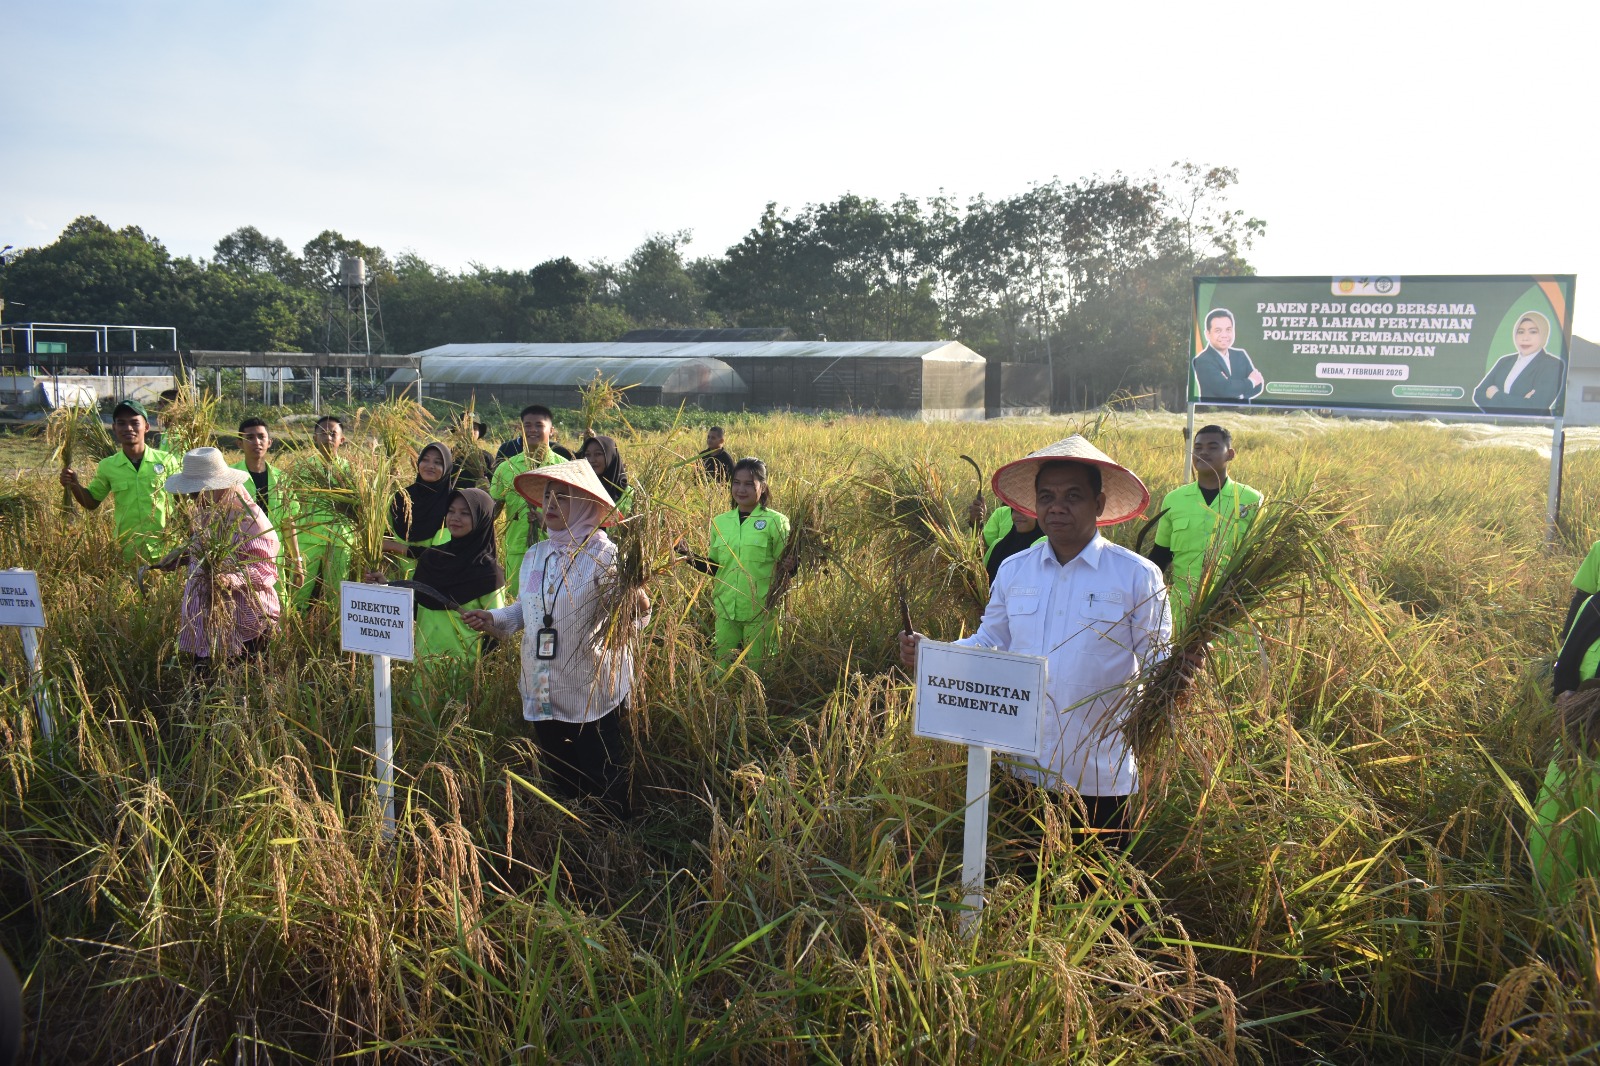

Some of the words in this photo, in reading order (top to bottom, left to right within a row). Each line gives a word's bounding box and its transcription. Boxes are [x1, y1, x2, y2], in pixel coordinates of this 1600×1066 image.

[1257, 303, 1307, 313] PANEN
[1311, 303, 1347, 313] PADI
[1350, 303, 1393, 314] GOGO
[1396, 303, 1476, 315] BERSAMA
[1262, 317, 1277, 327] DI
[1280, 317, 1318, 327] TEFA
[1322, 317, 1376, 328] LAHAN
[1379, 317, 1473, 329] PERTANIAN
[1263, 330, 1348, 341] POLITEKNIK
[1351, 331, 1470, 343] PEMBANGUNAN
[1293, 344, 1377, 355] PERTANIAN
[1380, 345, 1436, 357] MEDAN
[1321, 367, 1345, 375] MEDAN,
[1352, 368, 1384, 376] FEBRUARI
[1, 587, 28, 595] KEPALA
[0, 599, 14, 607] UNIT
[15, 599, 35, 607] TEFA
[351, 600, 400, 615] DIREKTUR
[347, 613, 404, 629] POLBANGTAN
[360, 627, 391, 639] MEDAN
[927, 675, 1031, 702] KAPUSDIKTAN
[937, 693, 1018, 717] KEMENTAN
